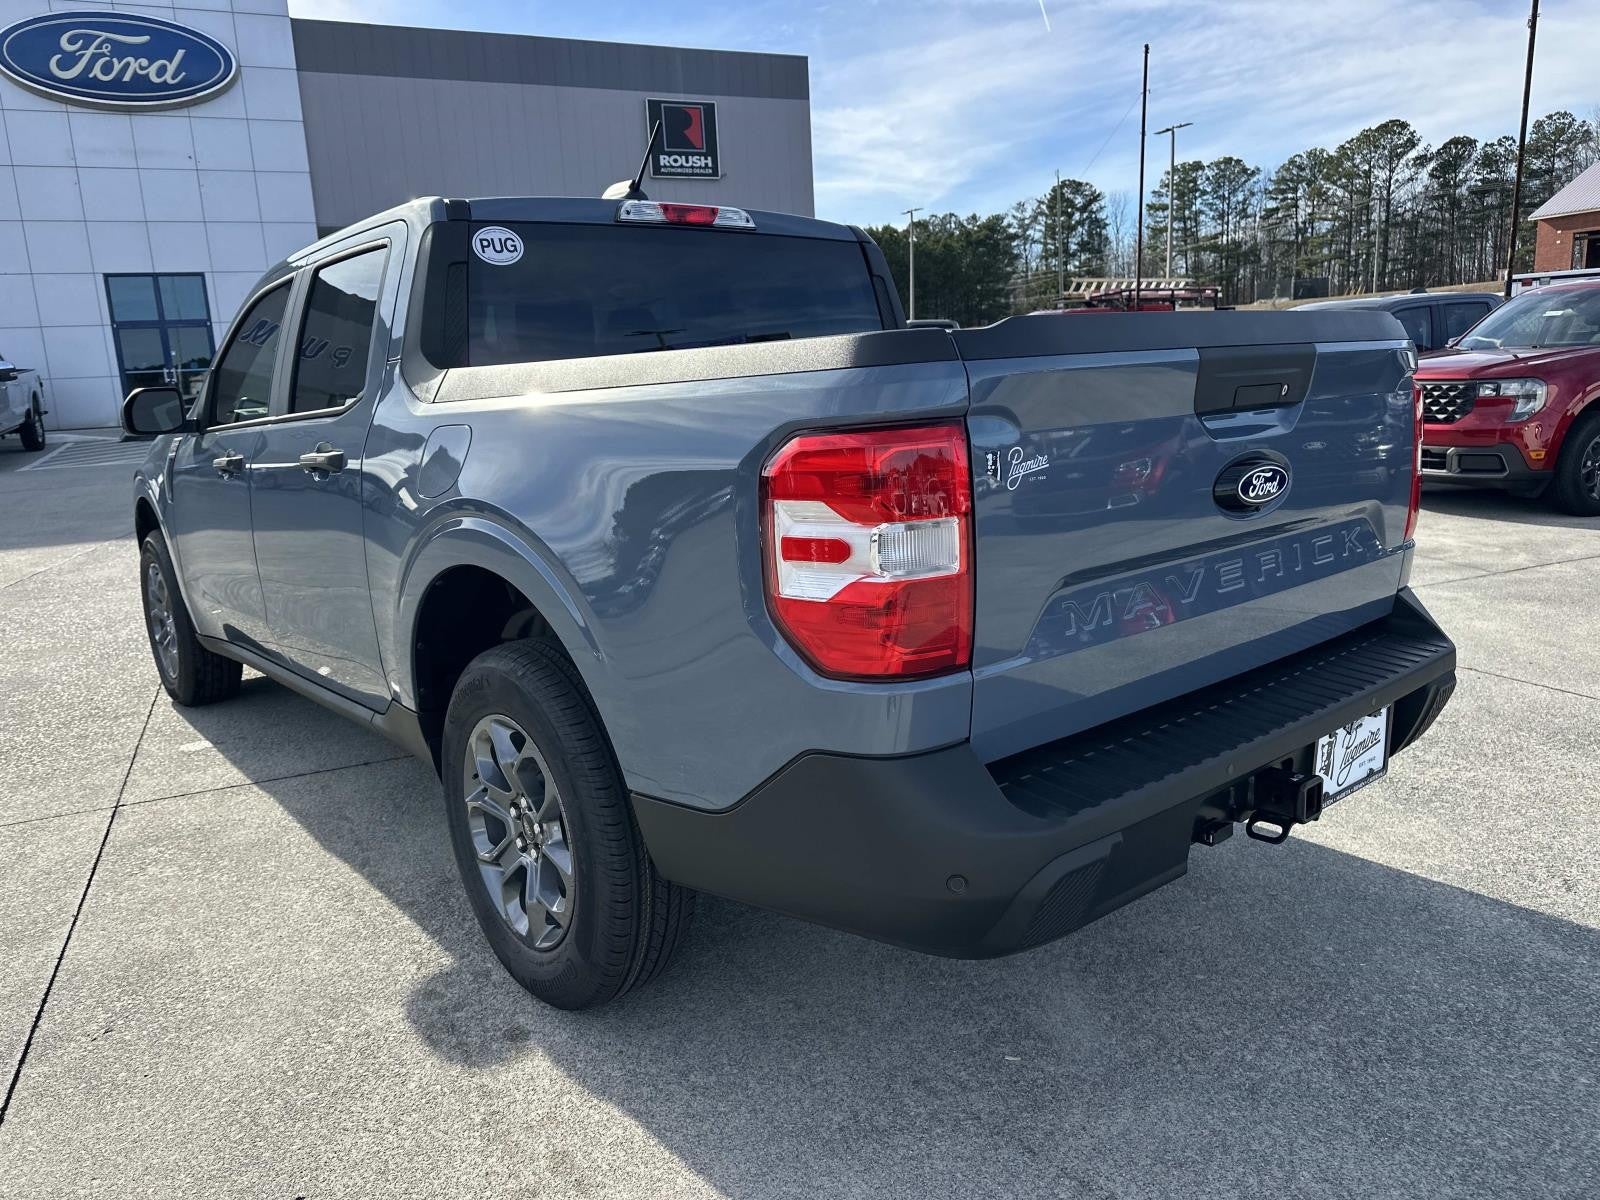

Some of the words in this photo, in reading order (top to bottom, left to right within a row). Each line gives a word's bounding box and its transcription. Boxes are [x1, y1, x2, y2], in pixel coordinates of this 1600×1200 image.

[49, 29, 187, 85] Ford
[659, 154, 713, 168] ROUSH
[479, 237, 518, 254] PUG
[1007, 446, 1050, 491] Pugmire
[1248, 471, 1280, 498] Ford
[1061, 526, 1364, 637] MAVERICK
